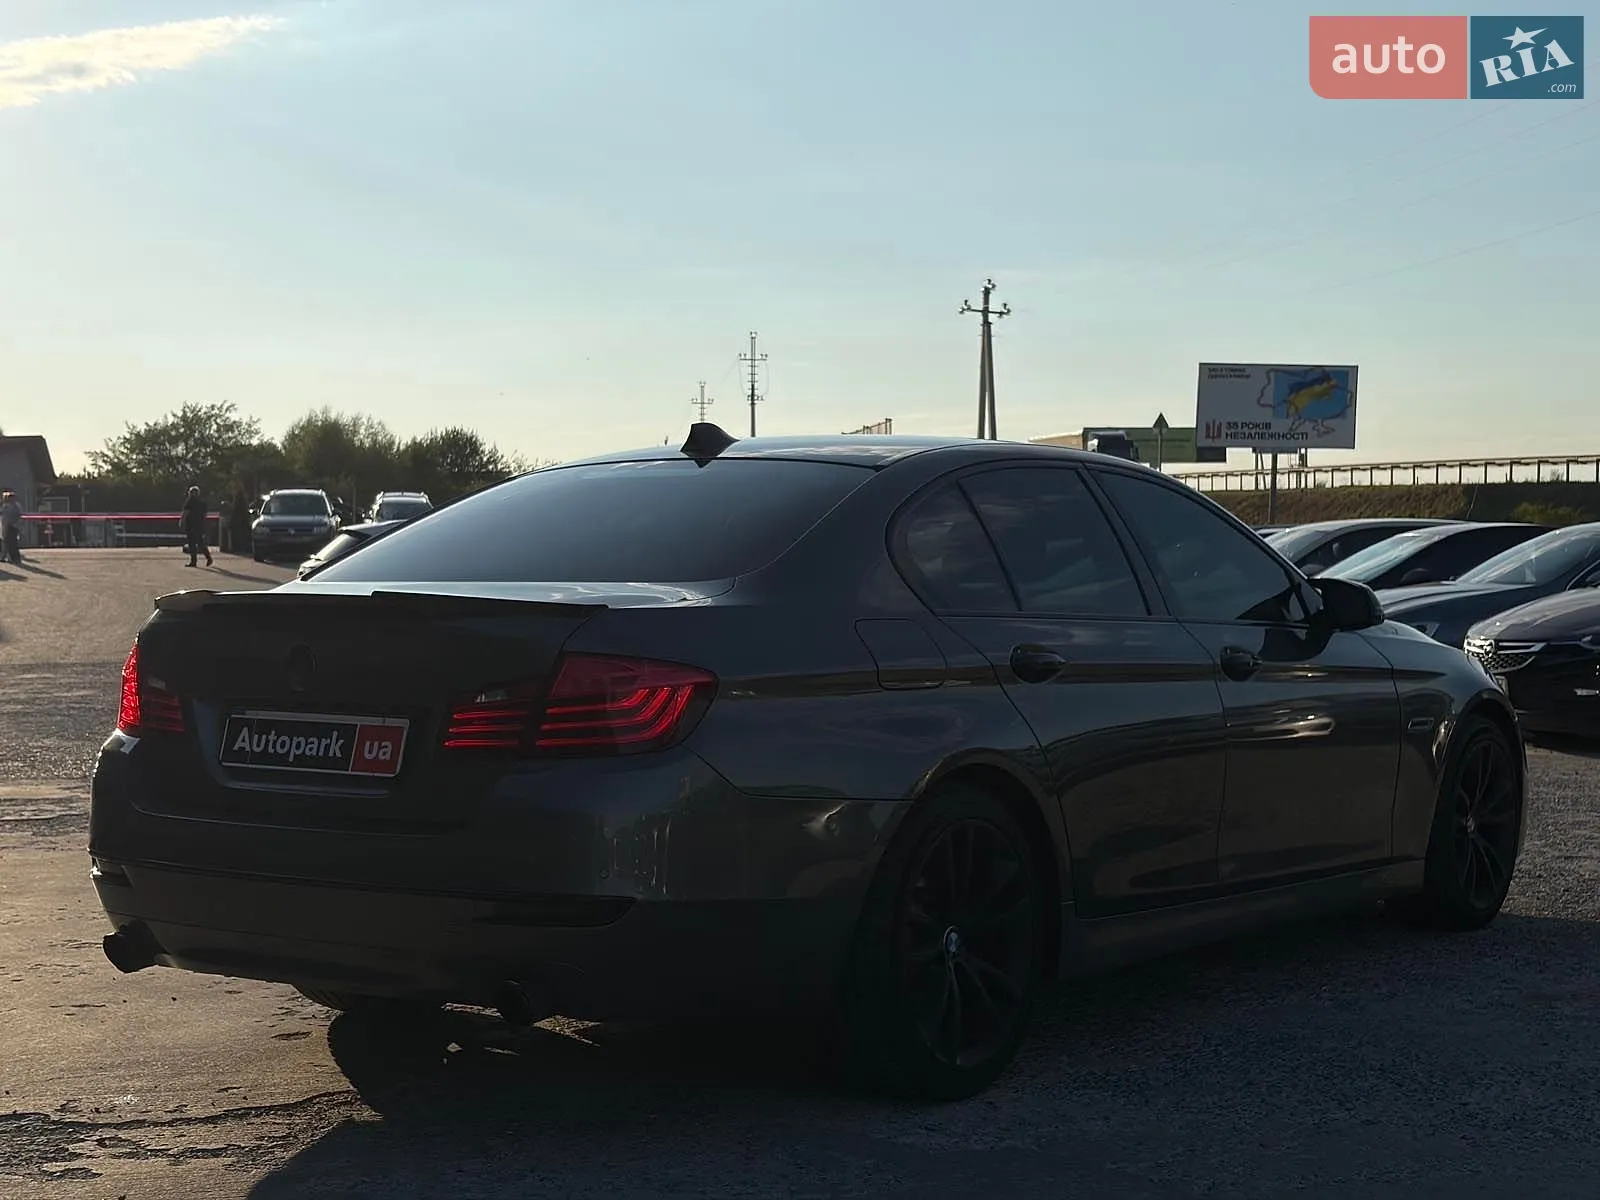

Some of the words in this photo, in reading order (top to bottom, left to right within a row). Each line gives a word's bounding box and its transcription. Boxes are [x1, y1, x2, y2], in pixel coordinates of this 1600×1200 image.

[1241, 421, 1272, 430] РОКІВ
[1225, 431, 1309, 440] НЕЗАЛЕЖНОСТІ
[233, 726, 345, 762] Autopark
[364, 740, 393, 761] ua
